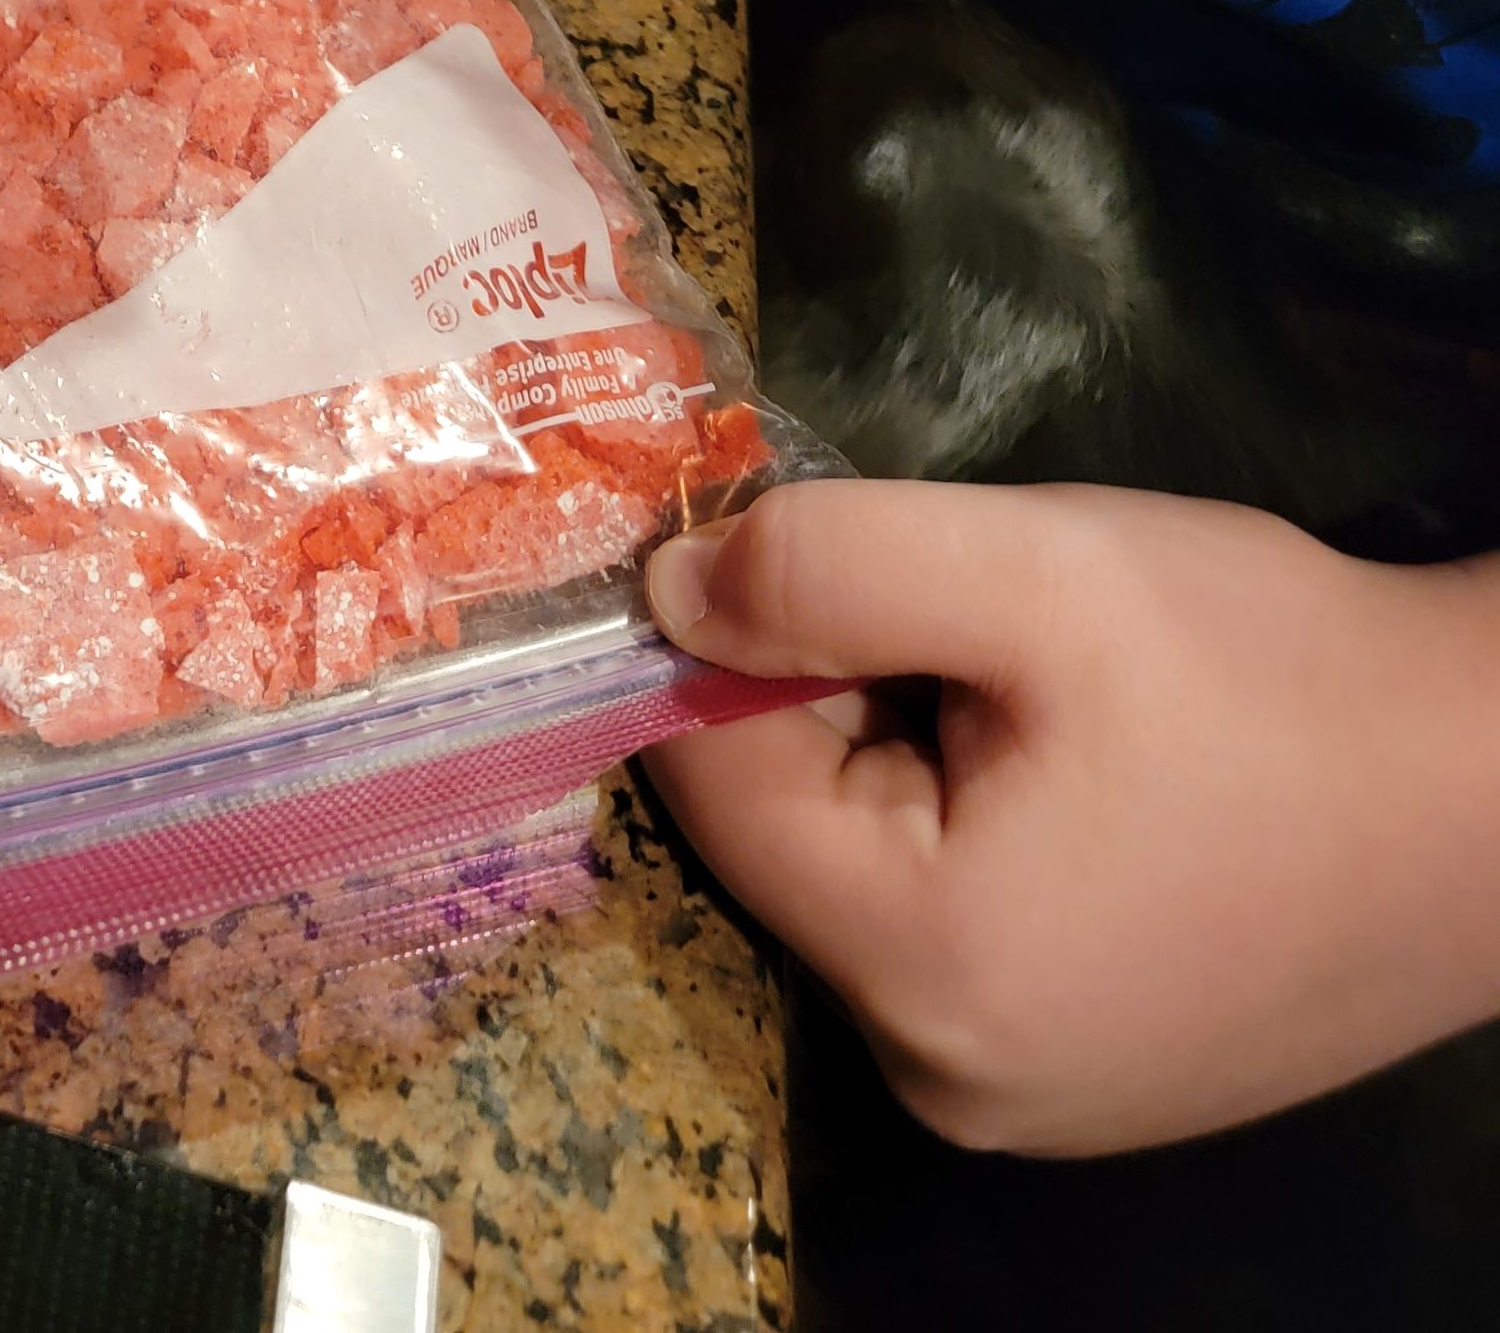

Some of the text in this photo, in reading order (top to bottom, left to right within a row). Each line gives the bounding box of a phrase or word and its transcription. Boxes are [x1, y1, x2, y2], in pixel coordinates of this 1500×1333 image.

[489, 208, 538, 248] BRAND
[462, 240, 592, 319] Ziploc
[495, 351, 591, 389] Entreprise
[560, 372, 619, 404] Family
[575, 381, 684, 426] Johnson
